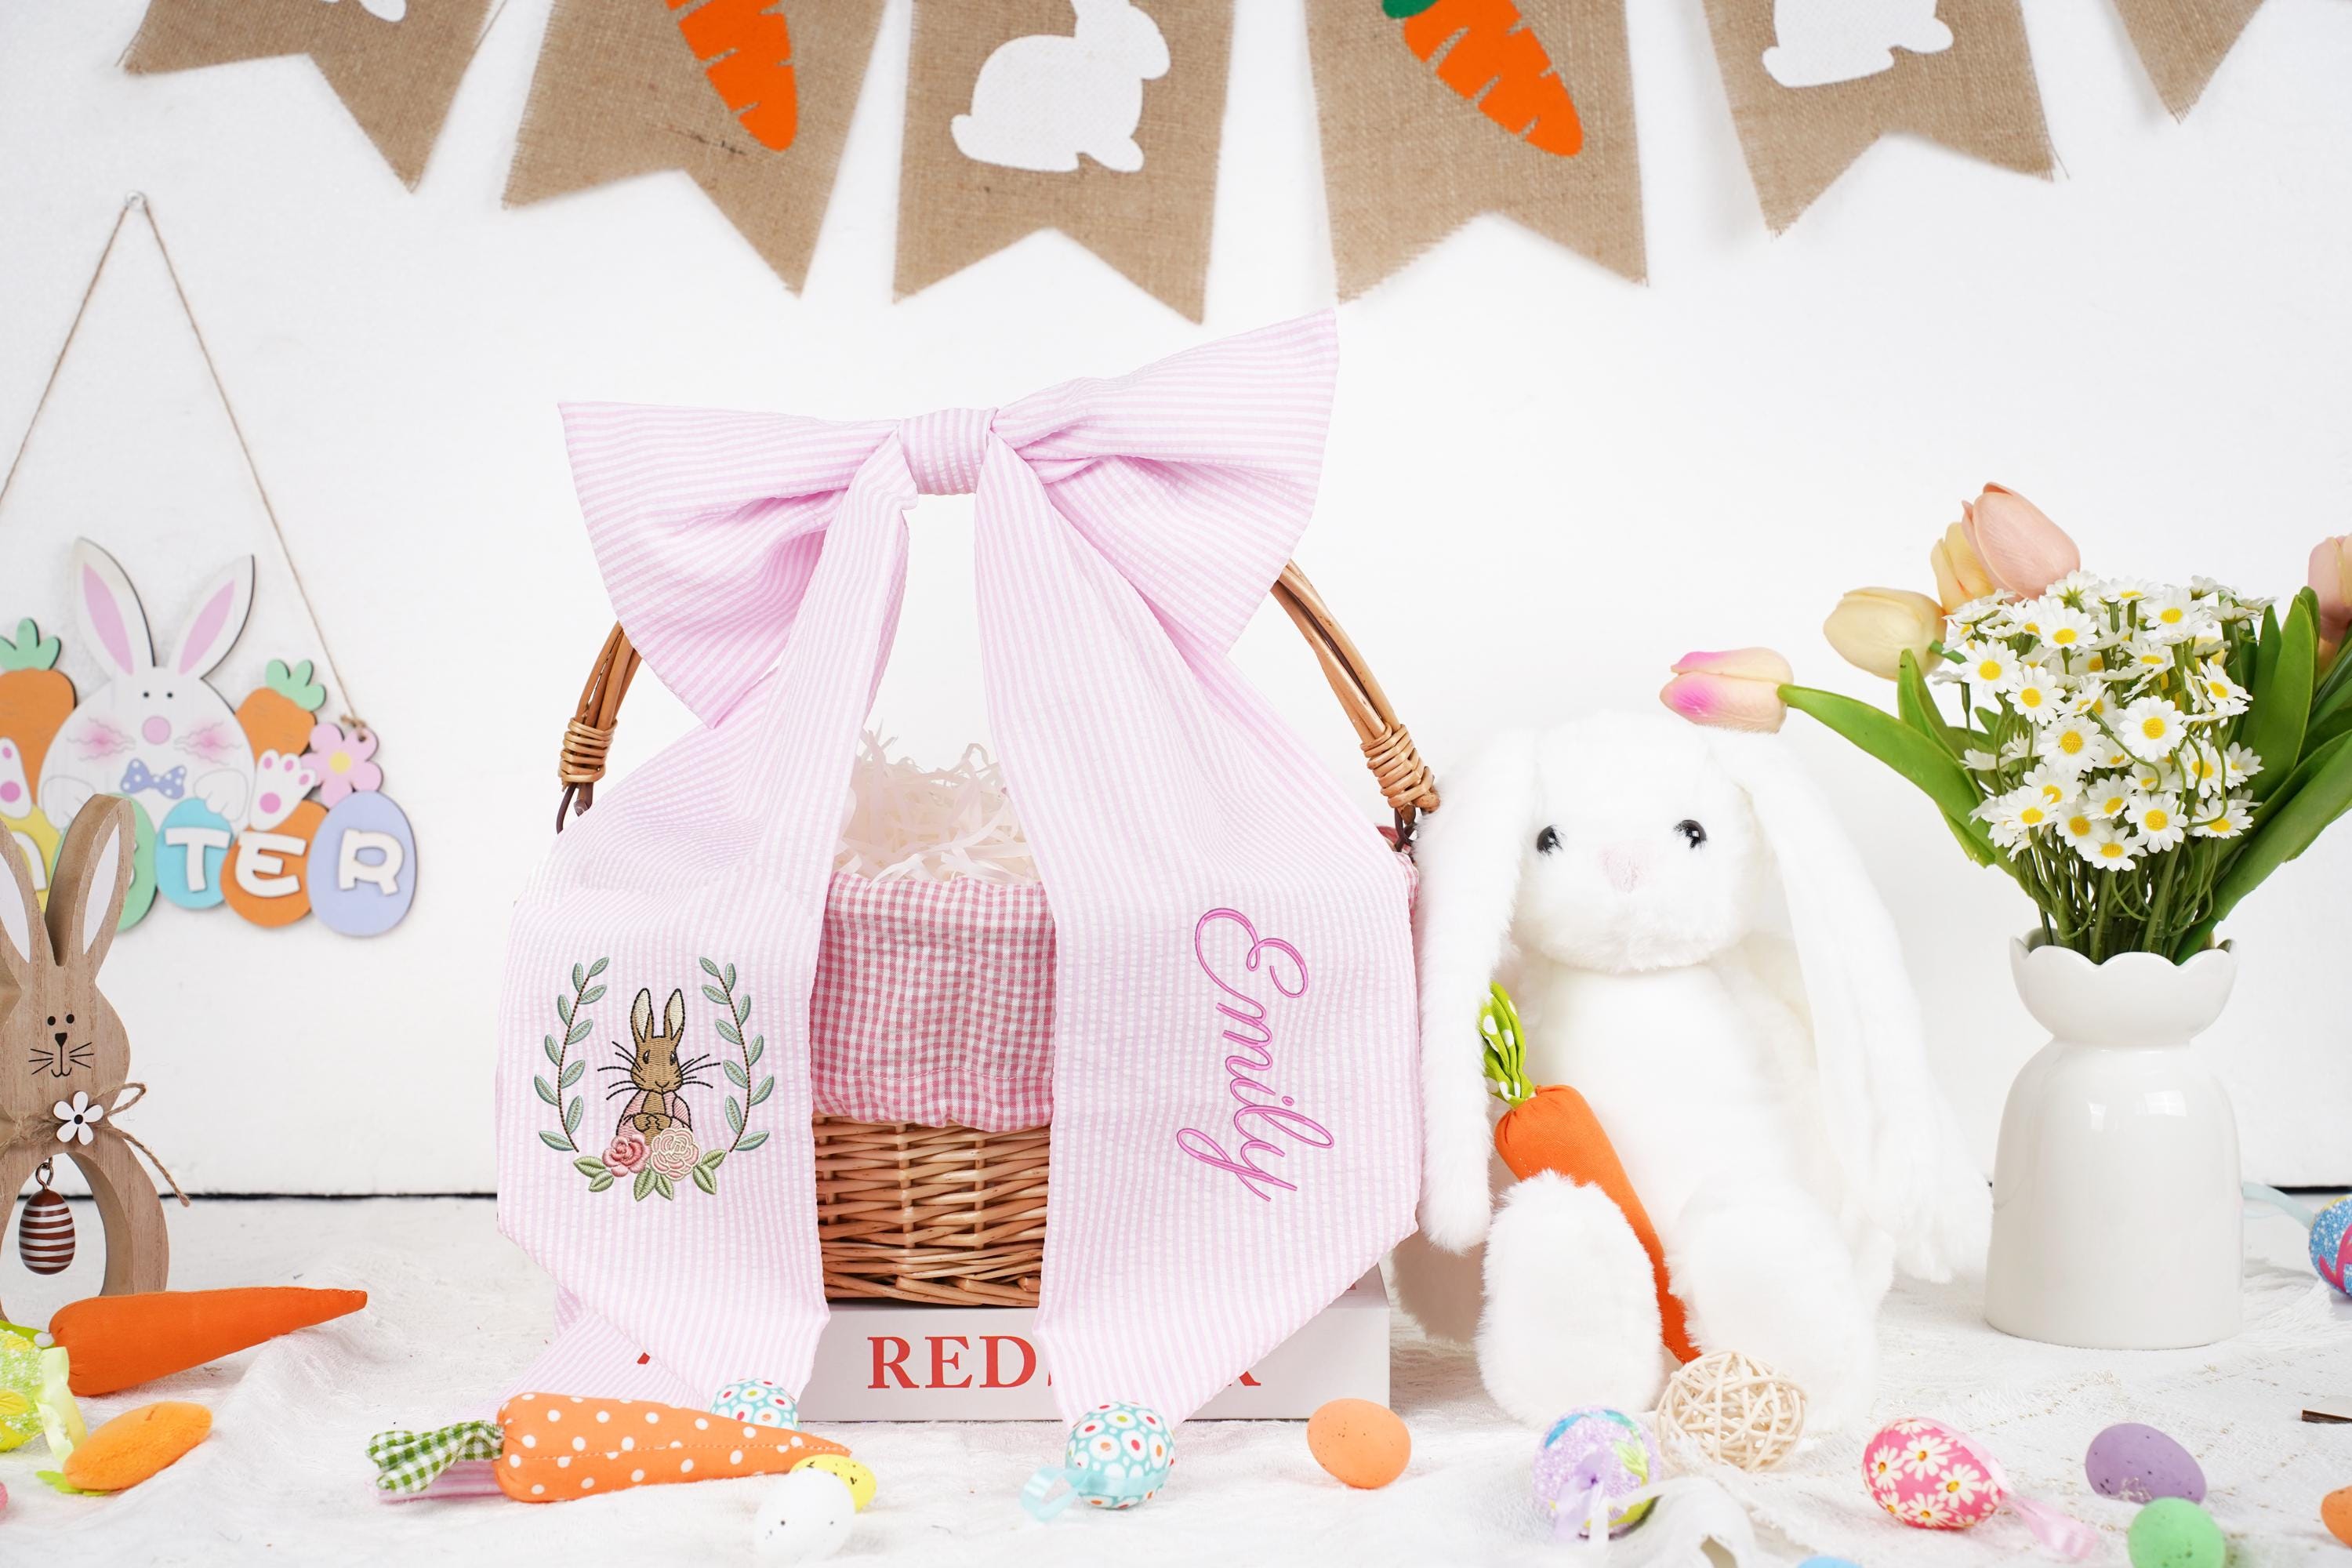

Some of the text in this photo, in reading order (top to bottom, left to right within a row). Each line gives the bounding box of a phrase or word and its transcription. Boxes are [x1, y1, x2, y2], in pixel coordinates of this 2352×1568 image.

[11, 827, 405, 898] TER
[1177, 907, 1334, 1202] Emily
[867, 1335, 1051, 1388] RED
